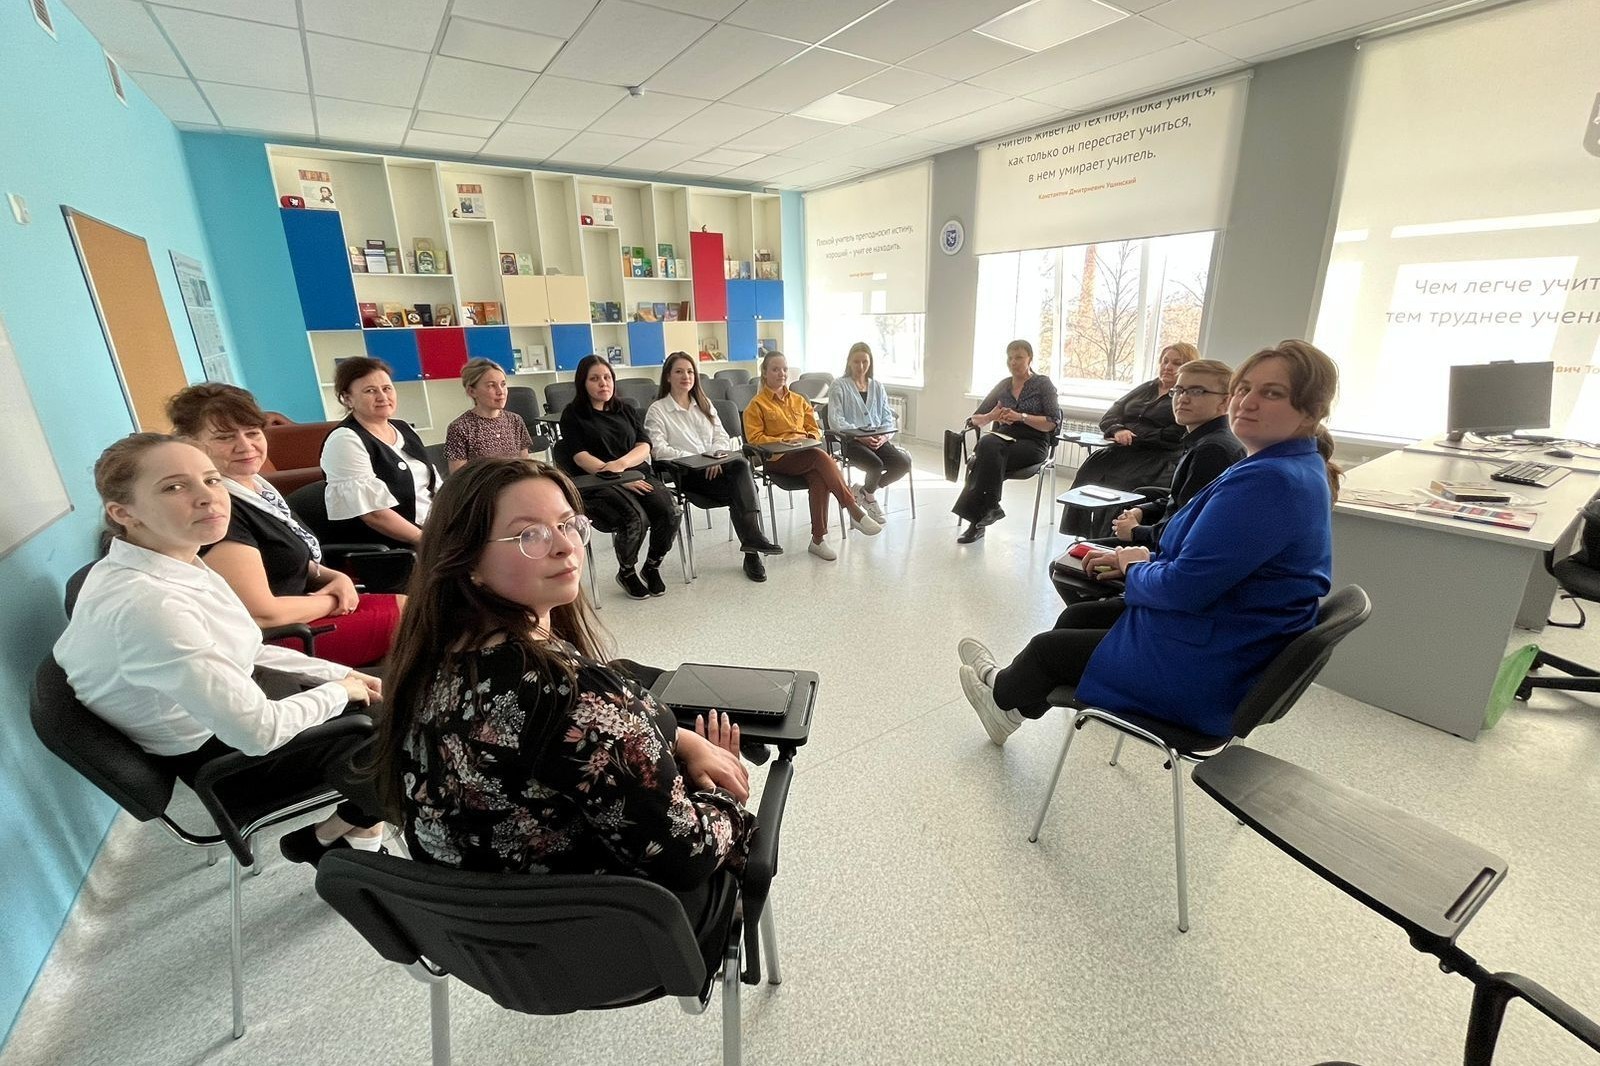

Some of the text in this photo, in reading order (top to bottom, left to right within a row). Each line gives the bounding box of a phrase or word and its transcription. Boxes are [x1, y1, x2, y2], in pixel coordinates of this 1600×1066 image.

[1008, 116, 1192, 167] как только он перестает учиться,
[1028, 149, 1157, 183] в нем умирает учитель.
[1068, 183, 1105, 196] Дмитриевич
[1105, 177, 1137, 189] Ушинский
[835, 235, 855, 247] учитель
[1415, 279, 1458, 295] Чем
[1463, 279, 1532, 294] легче
[1385, 311, 1422, 324] тем
[1429, 311, 1522, 328] труднее
